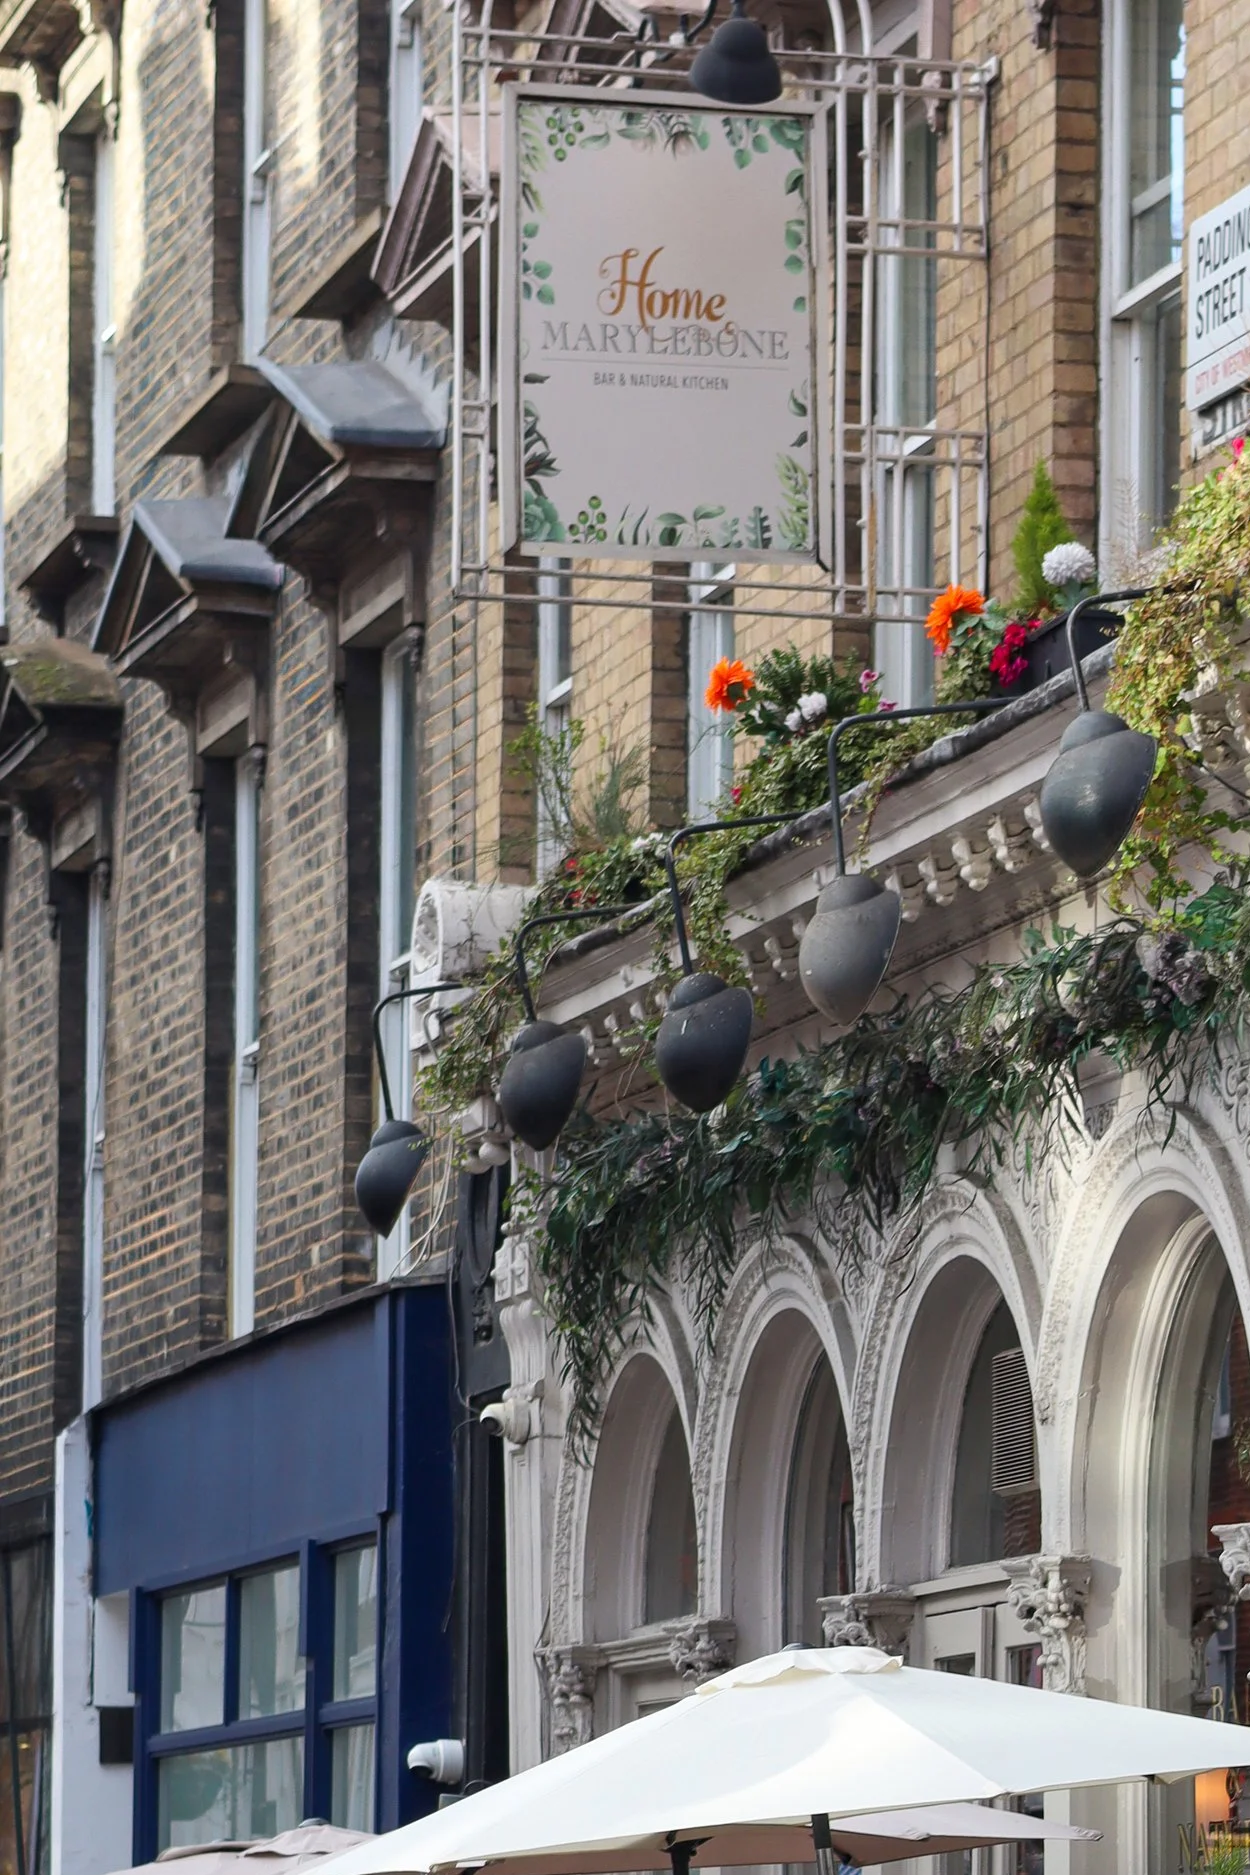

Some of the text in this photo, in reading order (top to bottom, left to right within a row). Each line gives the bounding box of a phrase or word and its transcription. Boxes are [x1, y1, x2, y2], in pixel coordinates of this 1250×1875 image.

[597, 246, 737, 338] Home
[1195, 266, 1246, 339] STREET
[541, 320, 790, 361] MARYLEBONE
[594, 372, 729, 390] BAR & NATURAL KITCHEN
